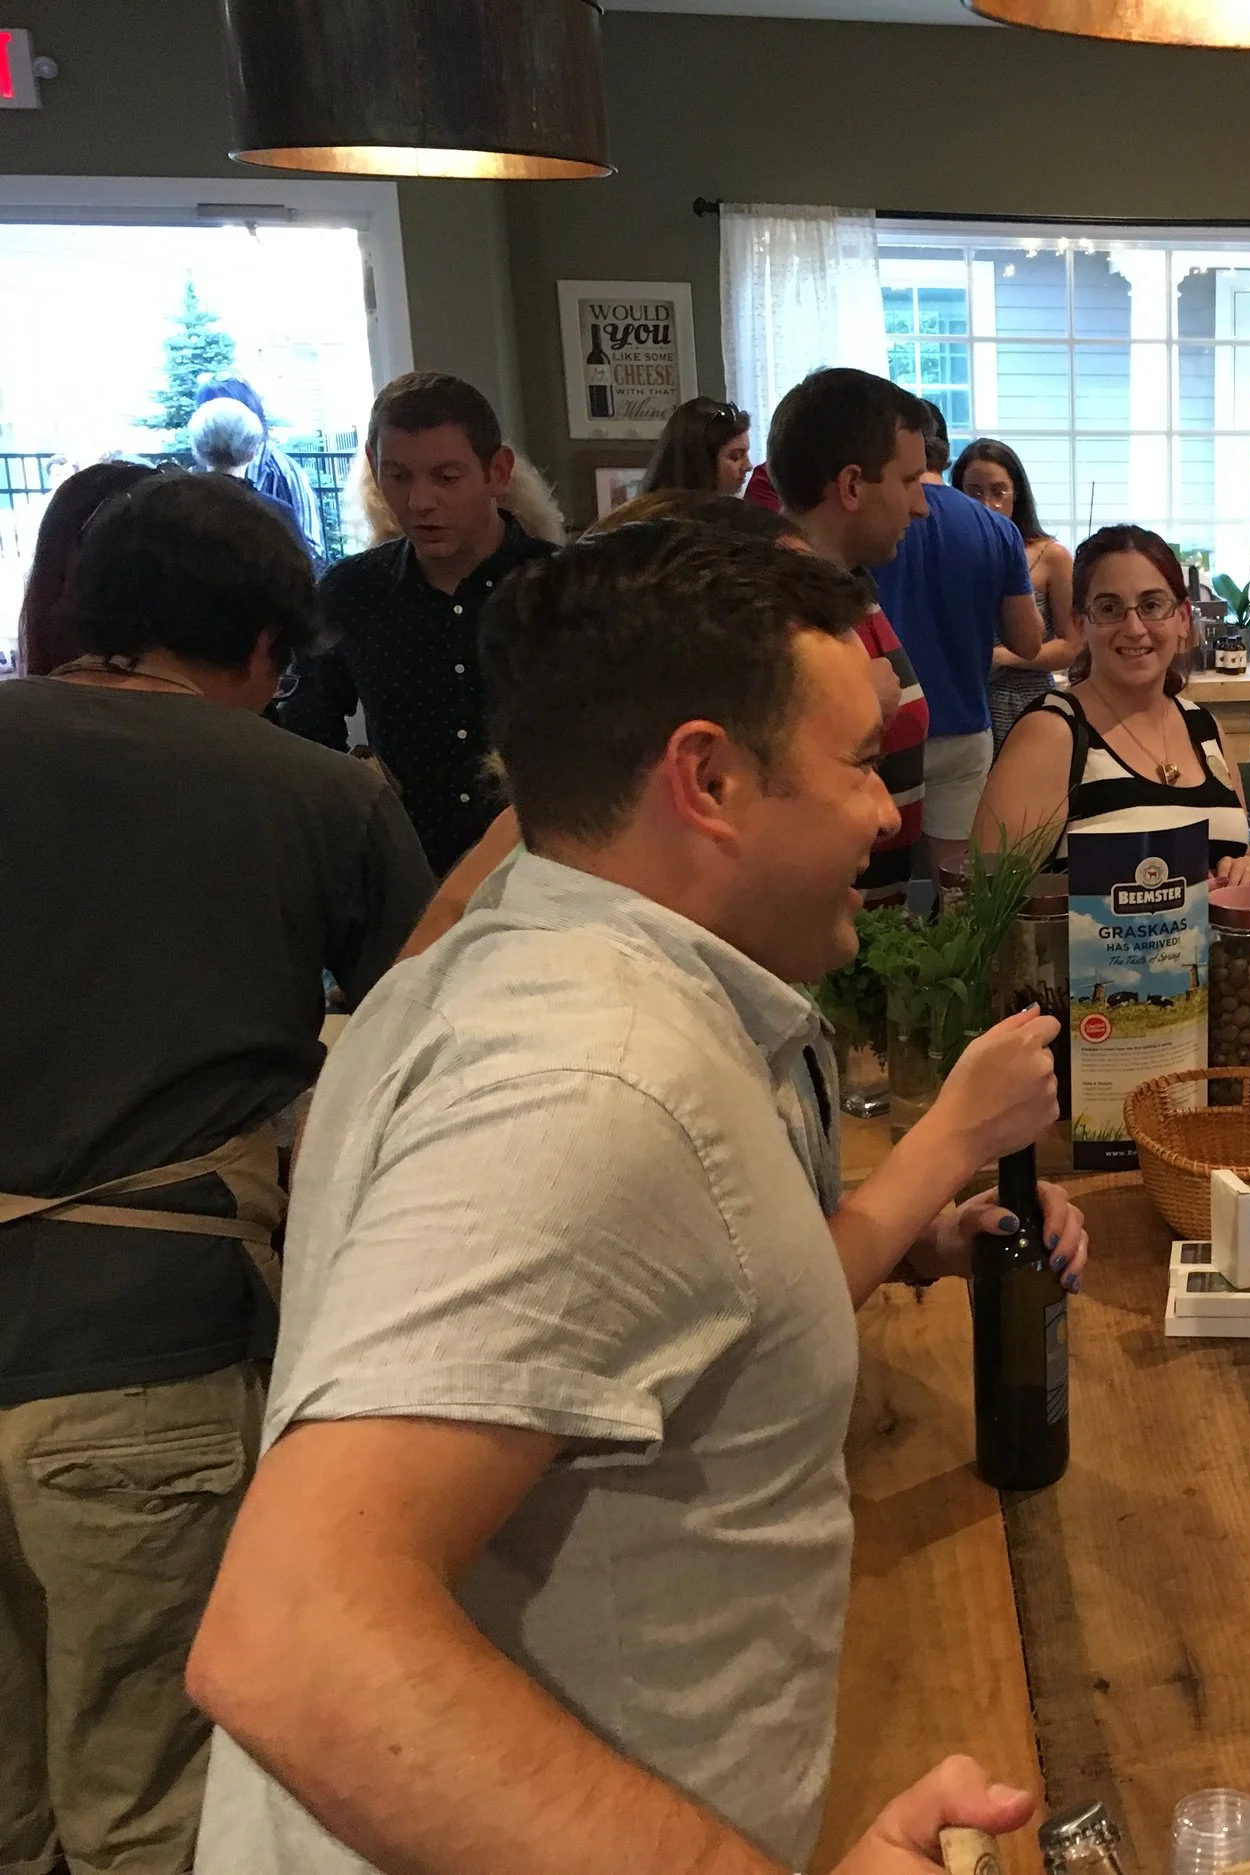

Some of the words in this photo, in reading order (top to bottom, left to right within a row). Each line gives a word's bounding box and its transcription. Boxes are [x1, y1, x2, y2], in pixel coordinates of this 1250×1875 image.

[589, 304, 671, 321] WOULD
[612, 352, 641, 361] LIKE
[645, 353, 674, 362] SOME
[613, 364, 675, 386] CHEESE
[1118, 887, 1182, 905] BEEMSTER
[1098, 918, 1187, 939] GRASKAAS
[1106, 943, 1129, 952] HAS
[1133, 936, 1181, 951] ARRIVED!
[1108, 956, 1123, 966] The
[1125, 955, 1147, 967] Taste
[1148, 953, 1158, 965] of
[1158, 952, 1181, 965] Spring
